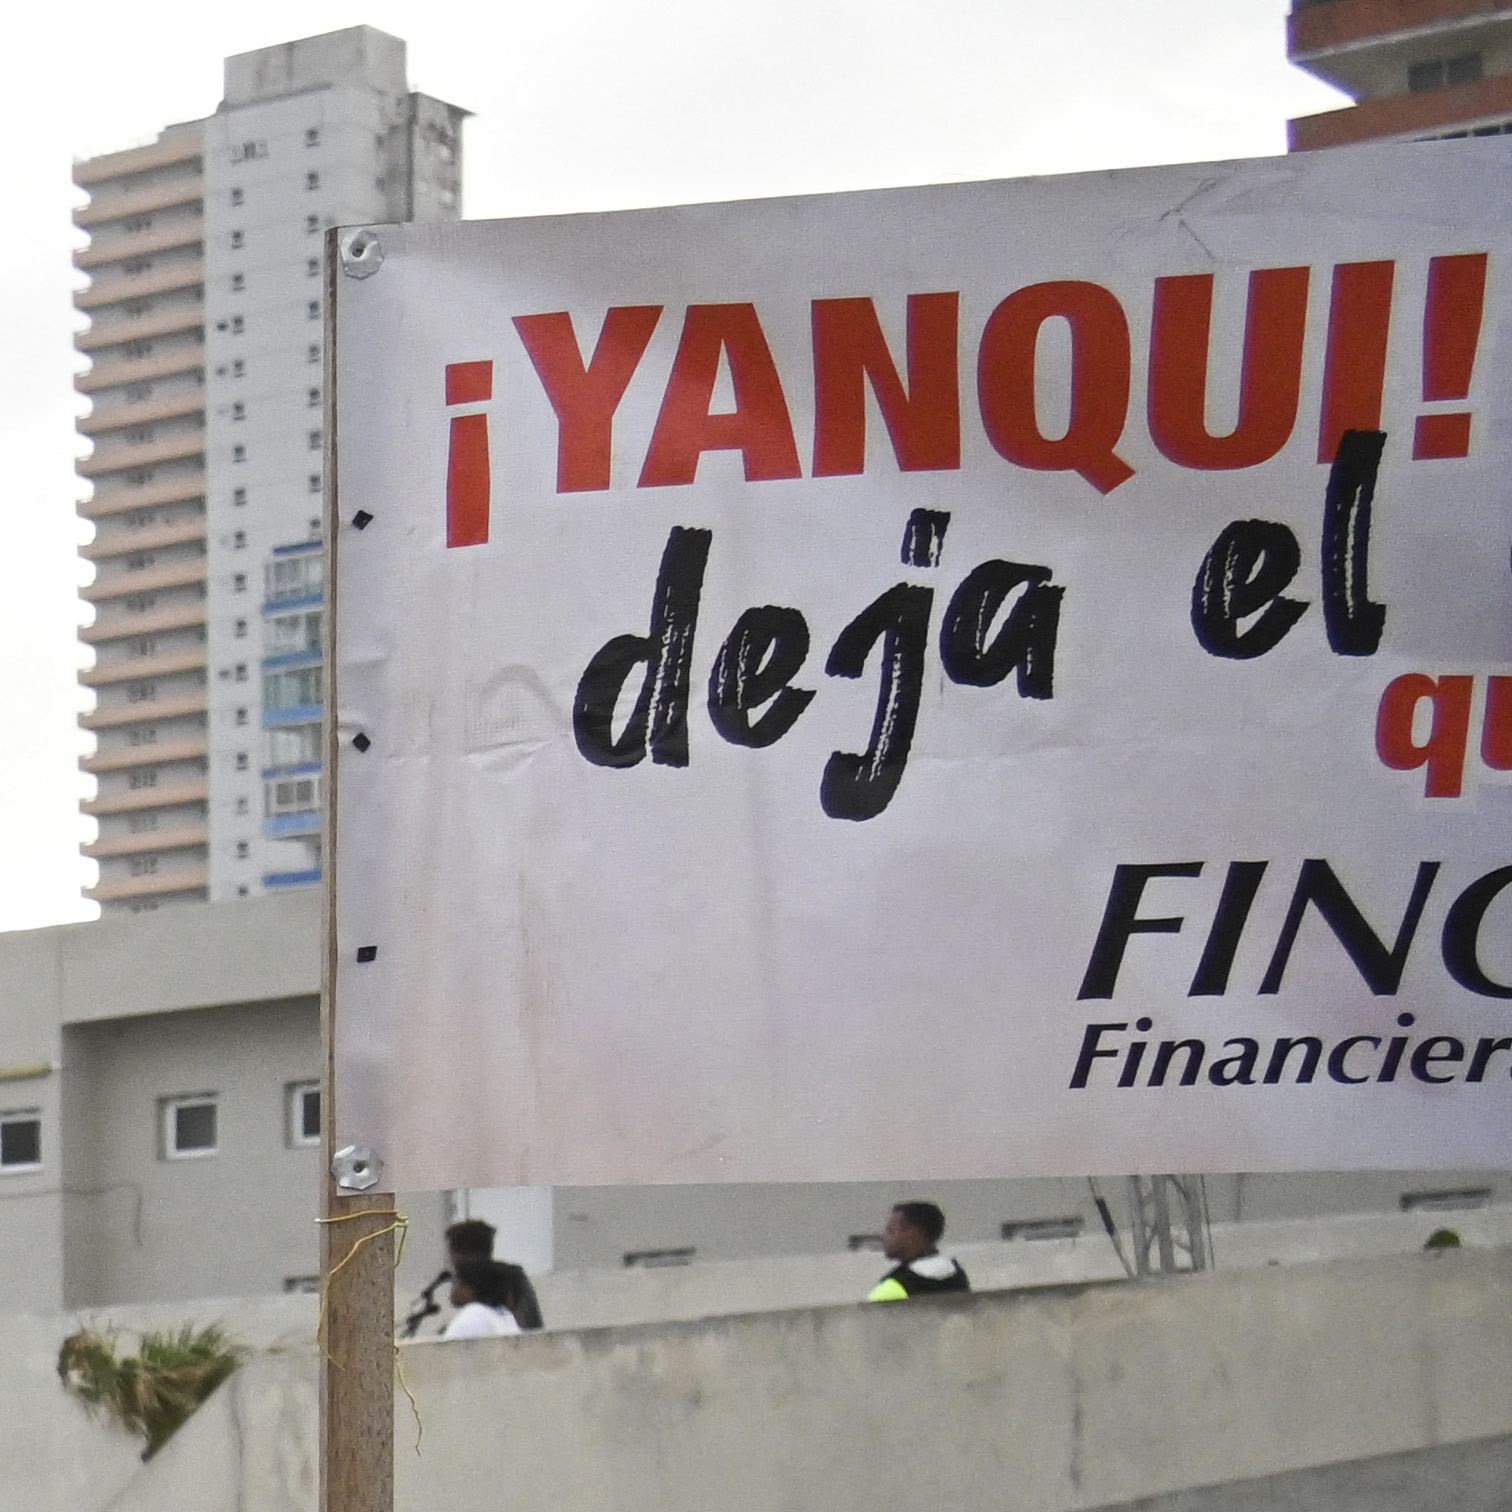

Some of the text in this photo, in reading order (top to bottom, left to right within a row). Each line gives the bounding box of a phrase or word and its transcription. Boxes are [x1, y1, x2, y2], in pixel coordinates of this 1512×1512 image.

[447, 253, 1489, 547] ¡YANQUI!
[572, 427, 1388, 822] deja el
[1068, 1012, 1512, 1089] Financier
